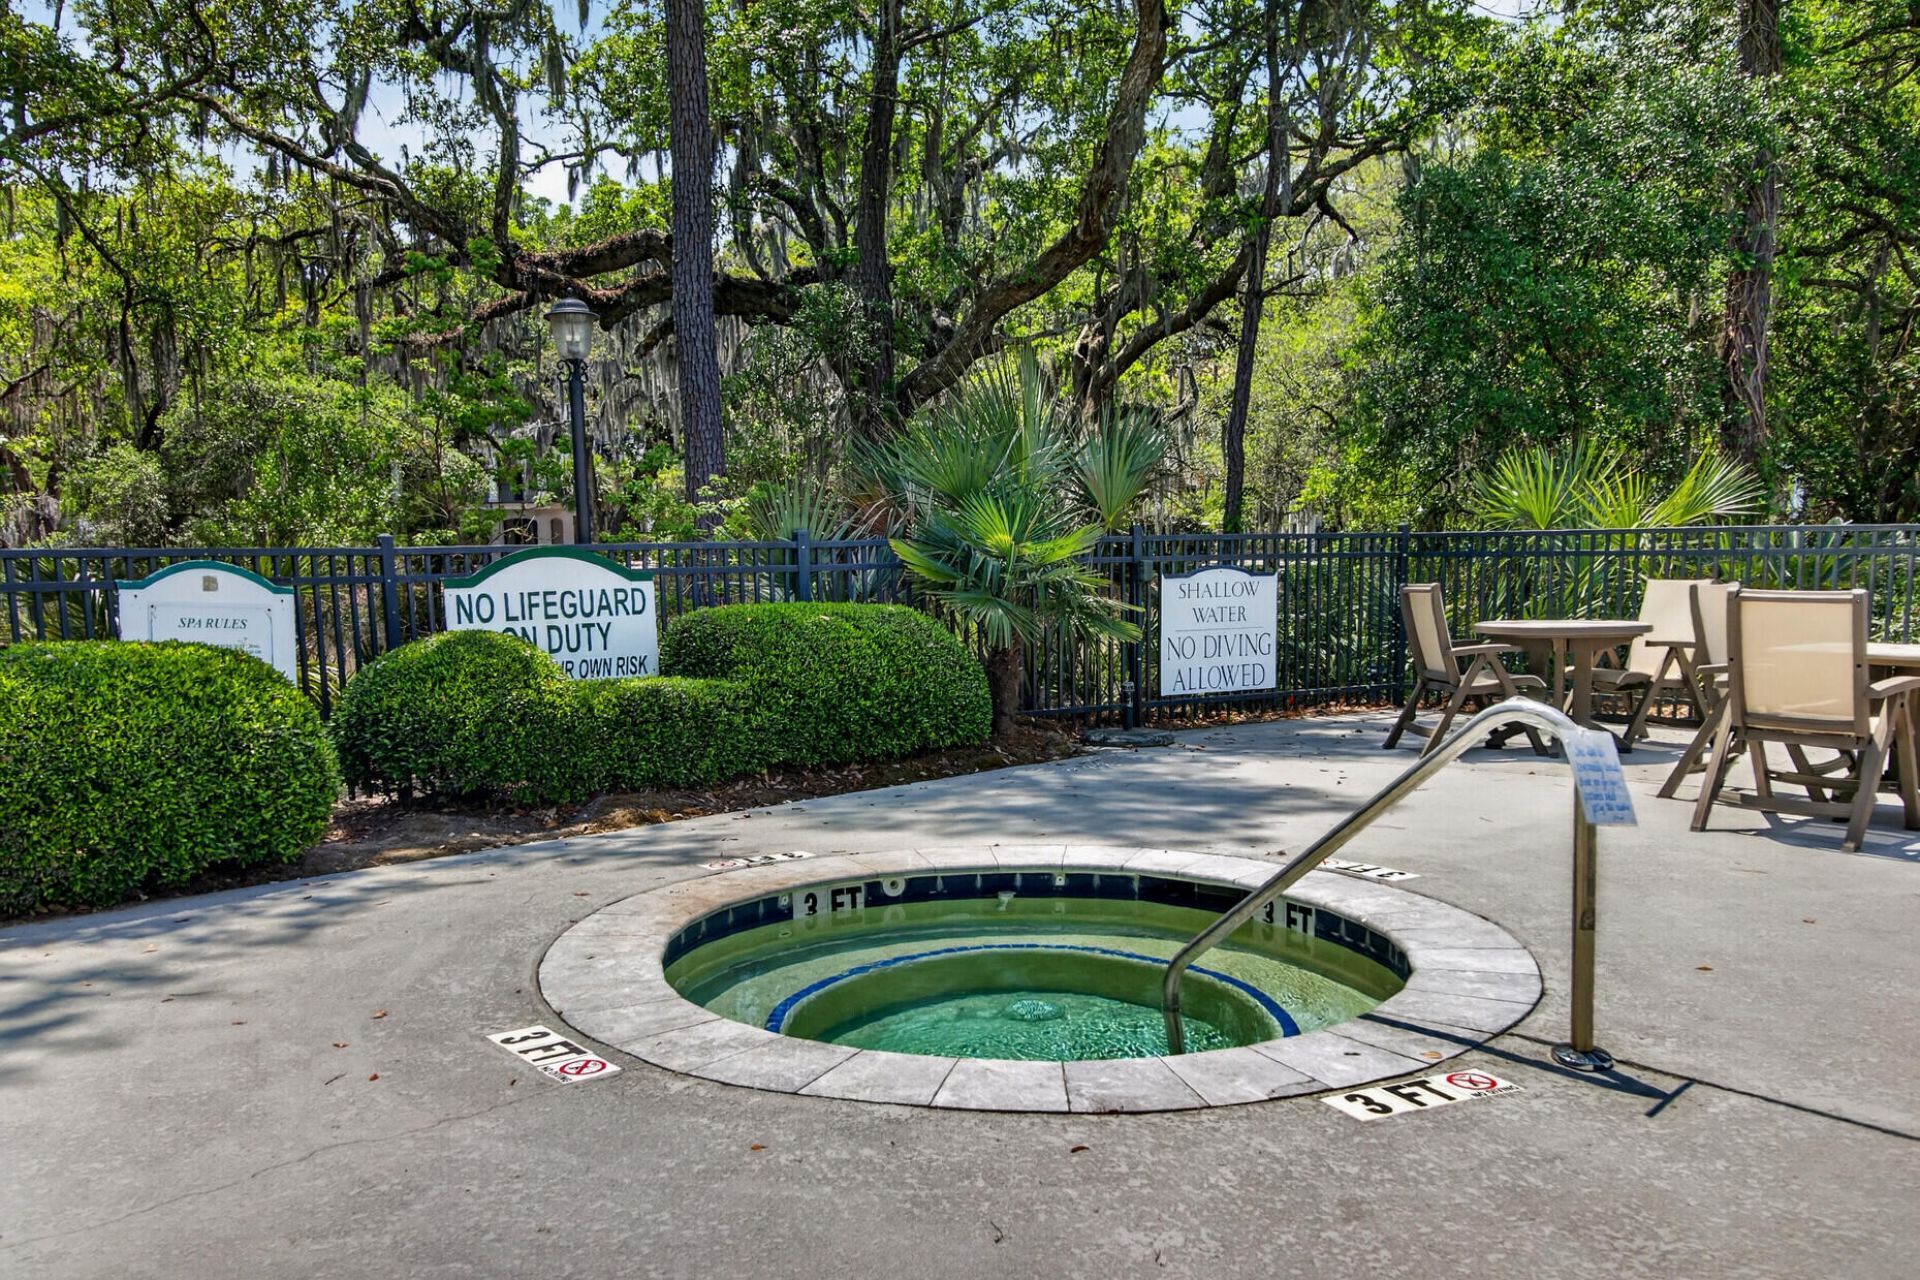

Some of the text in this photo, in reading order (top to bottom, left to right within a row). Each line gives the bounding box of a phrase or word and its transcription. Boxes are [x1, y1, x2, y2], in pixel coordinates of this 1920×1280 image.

[1178, 581, 1260, 599] SHALLOW
[456, 587, 646, 624] NO LIFEGUARD
[1193, 605, 1247, 624] WATER
[178, 617, 248, 630] SPA RULES
[547, 622, 612, 654] DUTY
[1167, 632, 1271, 661] NO DIVING
[579, 657, 612, 679] OWN
[616, 655, 648, 676] RISK
[1172, 662, 1266, 692] ALLOWED
[804, 886, 862, 916] 3 FT
[1285, 902, 1312, 934] FT
[500, 1030, 588, 1062] 3 FT
[1345, 1079, 1457, 1114] 3 FT
